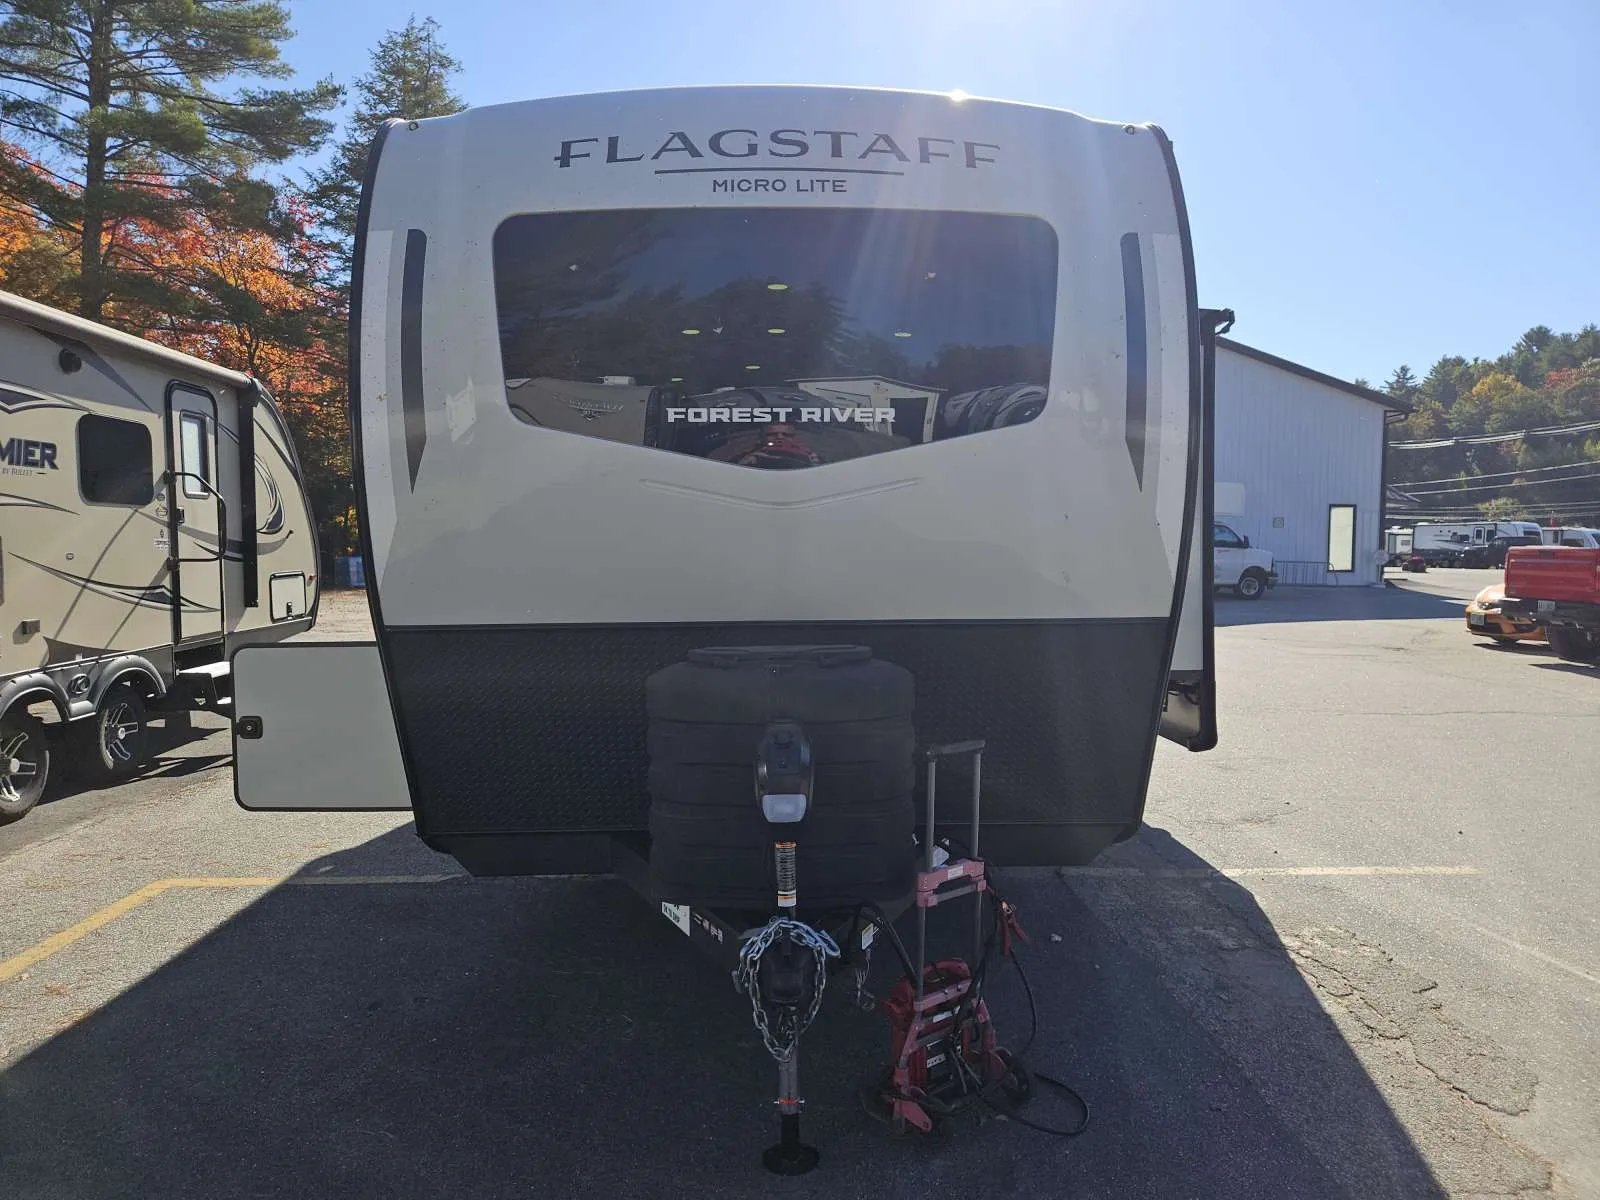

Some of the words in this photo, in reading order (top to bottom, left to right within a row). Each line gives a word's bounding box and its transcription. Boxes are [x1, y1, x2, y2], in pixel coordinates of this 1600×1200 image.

[553, 129, 1001, 169] FLAGSTAFF
[712, 178, 787, 193] MICRO
[796, 178, 848, 193] LITE
[665, 407, 793, 423] FOREST
[800, 407, 897, 423] RIVER
